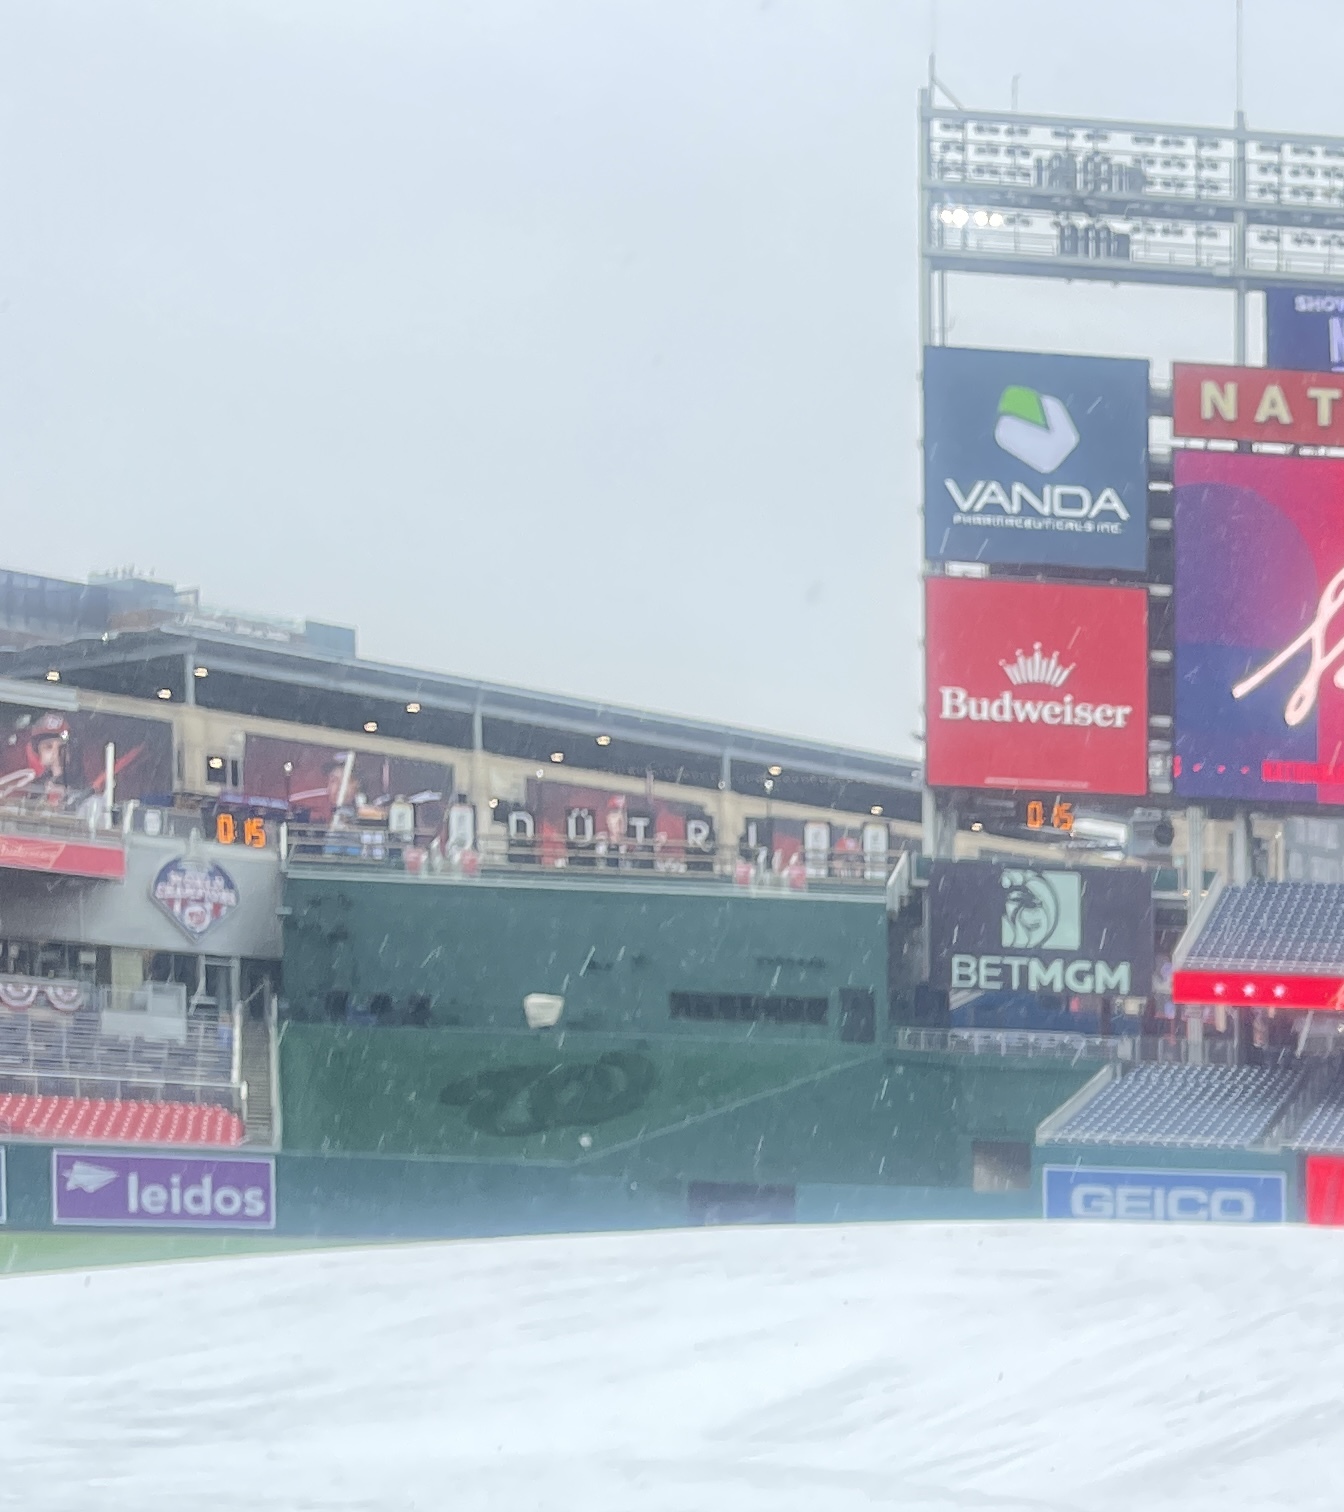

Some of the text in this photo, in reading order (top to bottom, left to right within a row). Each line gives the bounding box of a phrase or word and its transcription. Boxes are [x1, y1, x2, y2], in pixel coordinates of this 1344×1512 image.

[943, 477, 1131, 521] VANDA
[938, 685, 1133, 728] Budweiser
[951, 954, 1131, 995] BETMGM
[127, 1172, 266, 1217] leidos
[1071, 1184, 1255, 1221] GEICO
